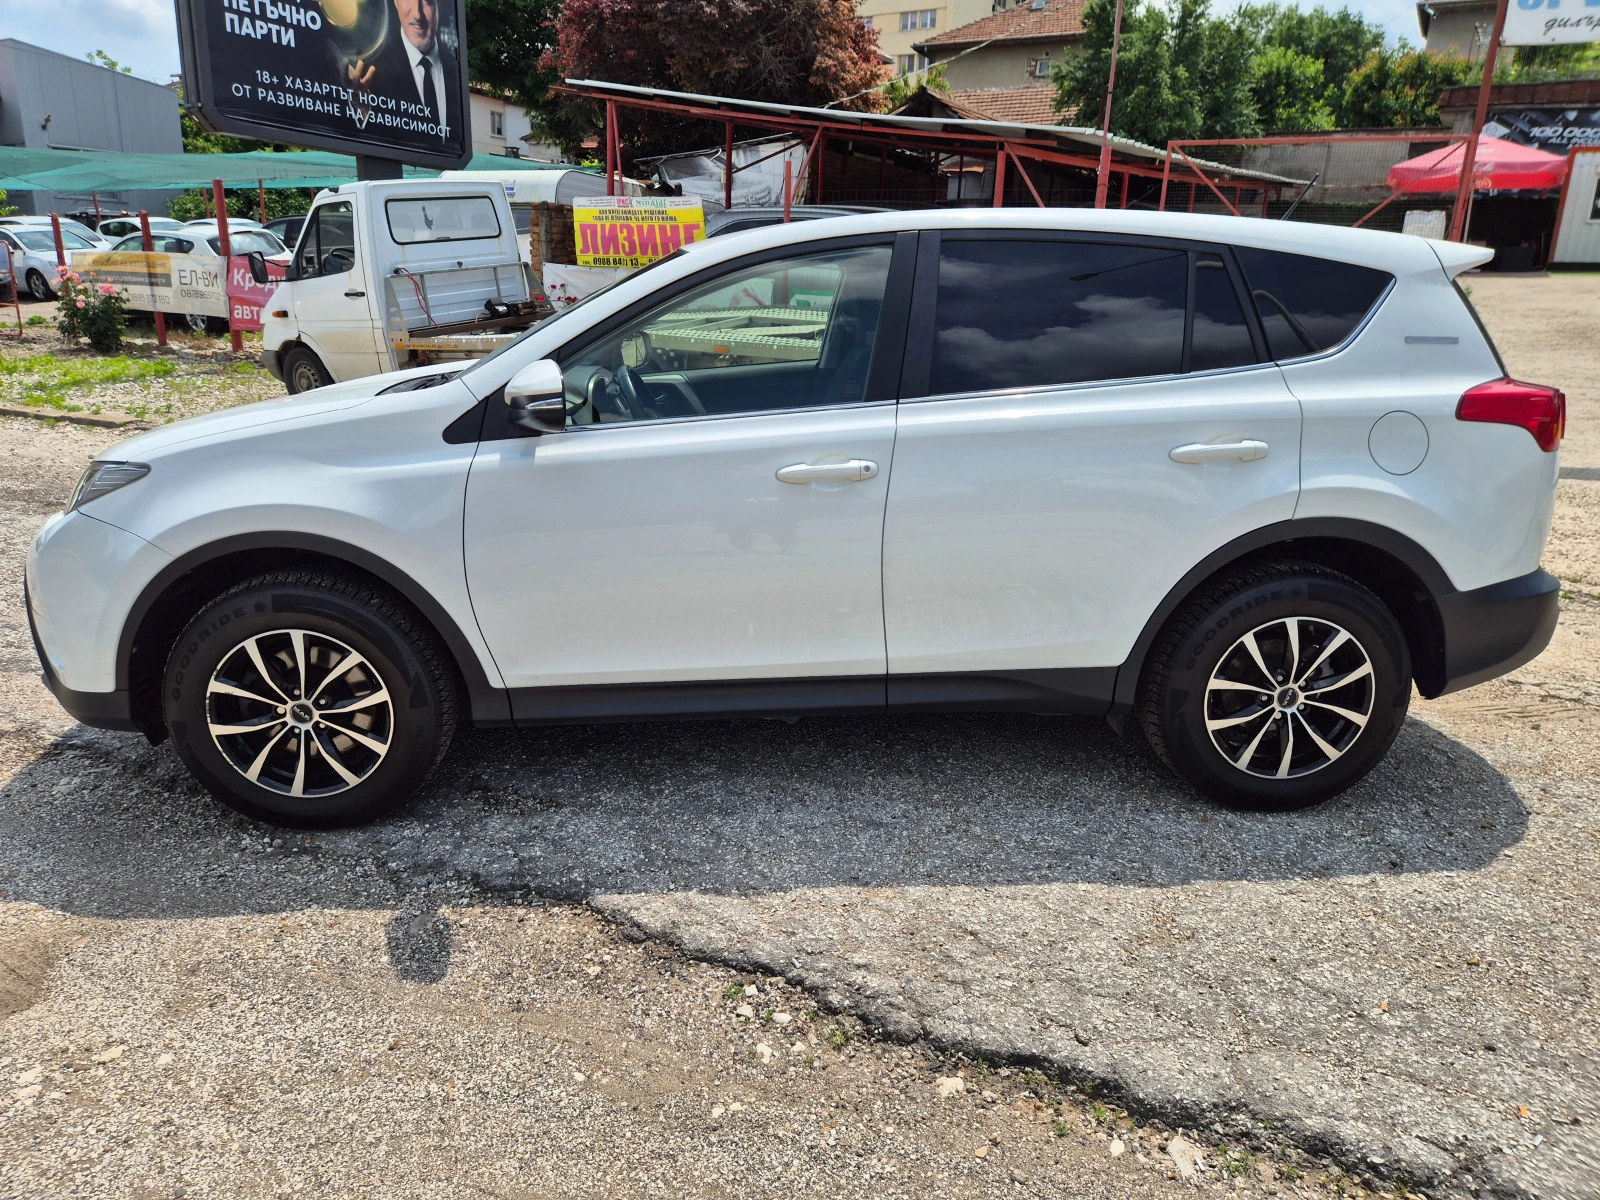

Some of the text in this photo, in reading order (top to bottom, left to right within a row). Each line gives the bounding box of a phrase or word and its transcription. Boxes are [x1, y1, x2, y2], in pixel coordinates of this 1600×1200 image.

[225, 12, 296, 48] ПАРТИ
[231, 83, 452, 138] ОТ РАЗВИВАНЕ НА ЗАВИСИМОСТ
[255, 69, 432, 119] 18+ ХАЗАРТЪТ НОСИ РИСК
[579, 223, 701, 257] ЛИЗИНГ
[178, 269, 219, 288] ЕЛ-ВИ
[233, 304, 264, 320] авт
[1186, 589, 1283, 671] GOODRIDE
[172, 606, 247, 701] GOODRIDE
